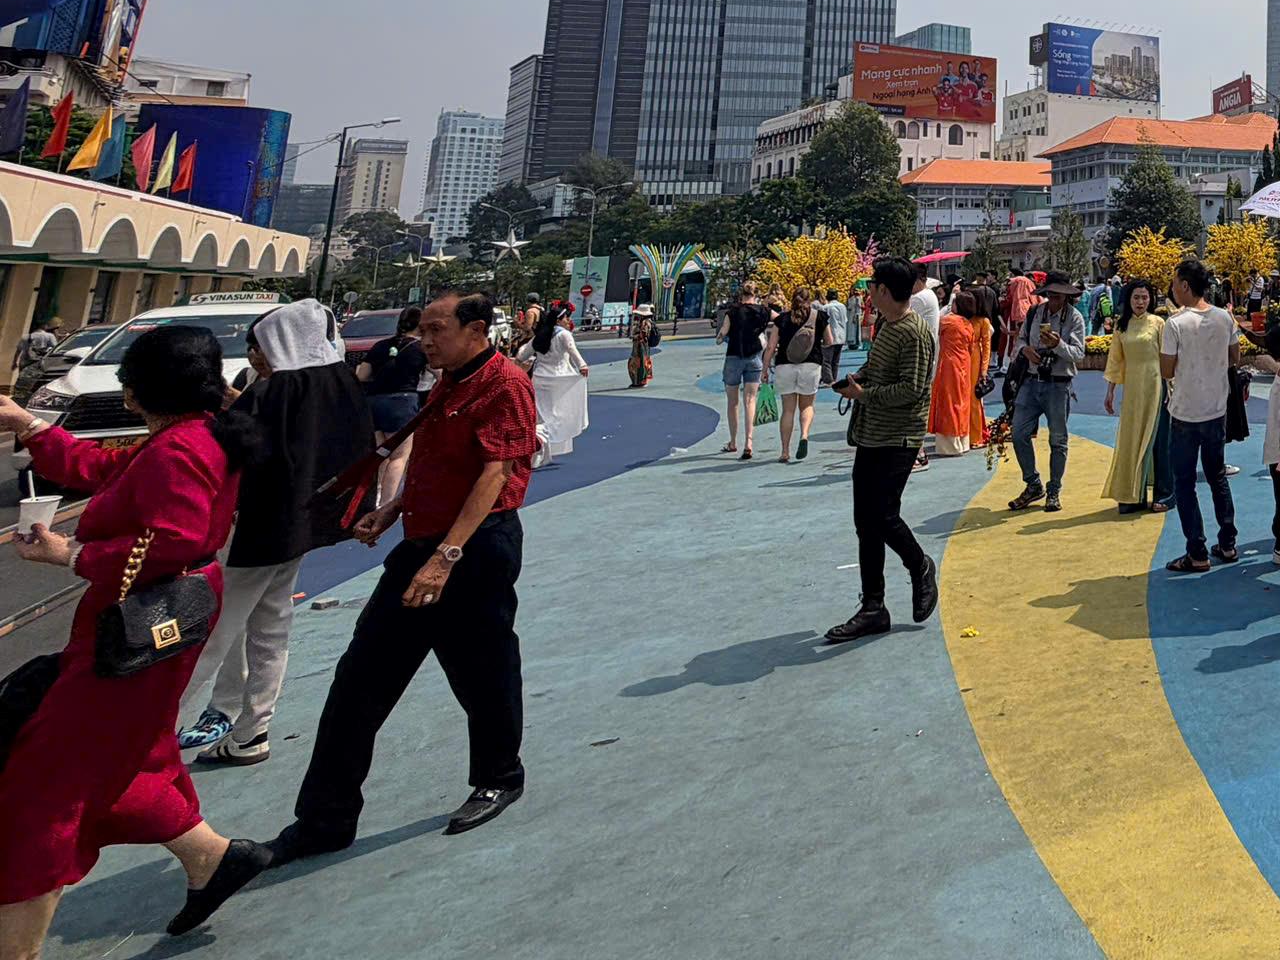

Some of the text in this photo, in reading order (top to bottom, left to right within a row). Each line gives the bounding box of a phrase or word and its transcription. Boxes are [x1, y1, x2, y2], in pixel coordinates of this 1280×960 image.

[861, 64, 942, 81] Mạng cực nhanh
[917, 87, 931, 95] Anh
[209, 293, 253, 302] VINASUN
